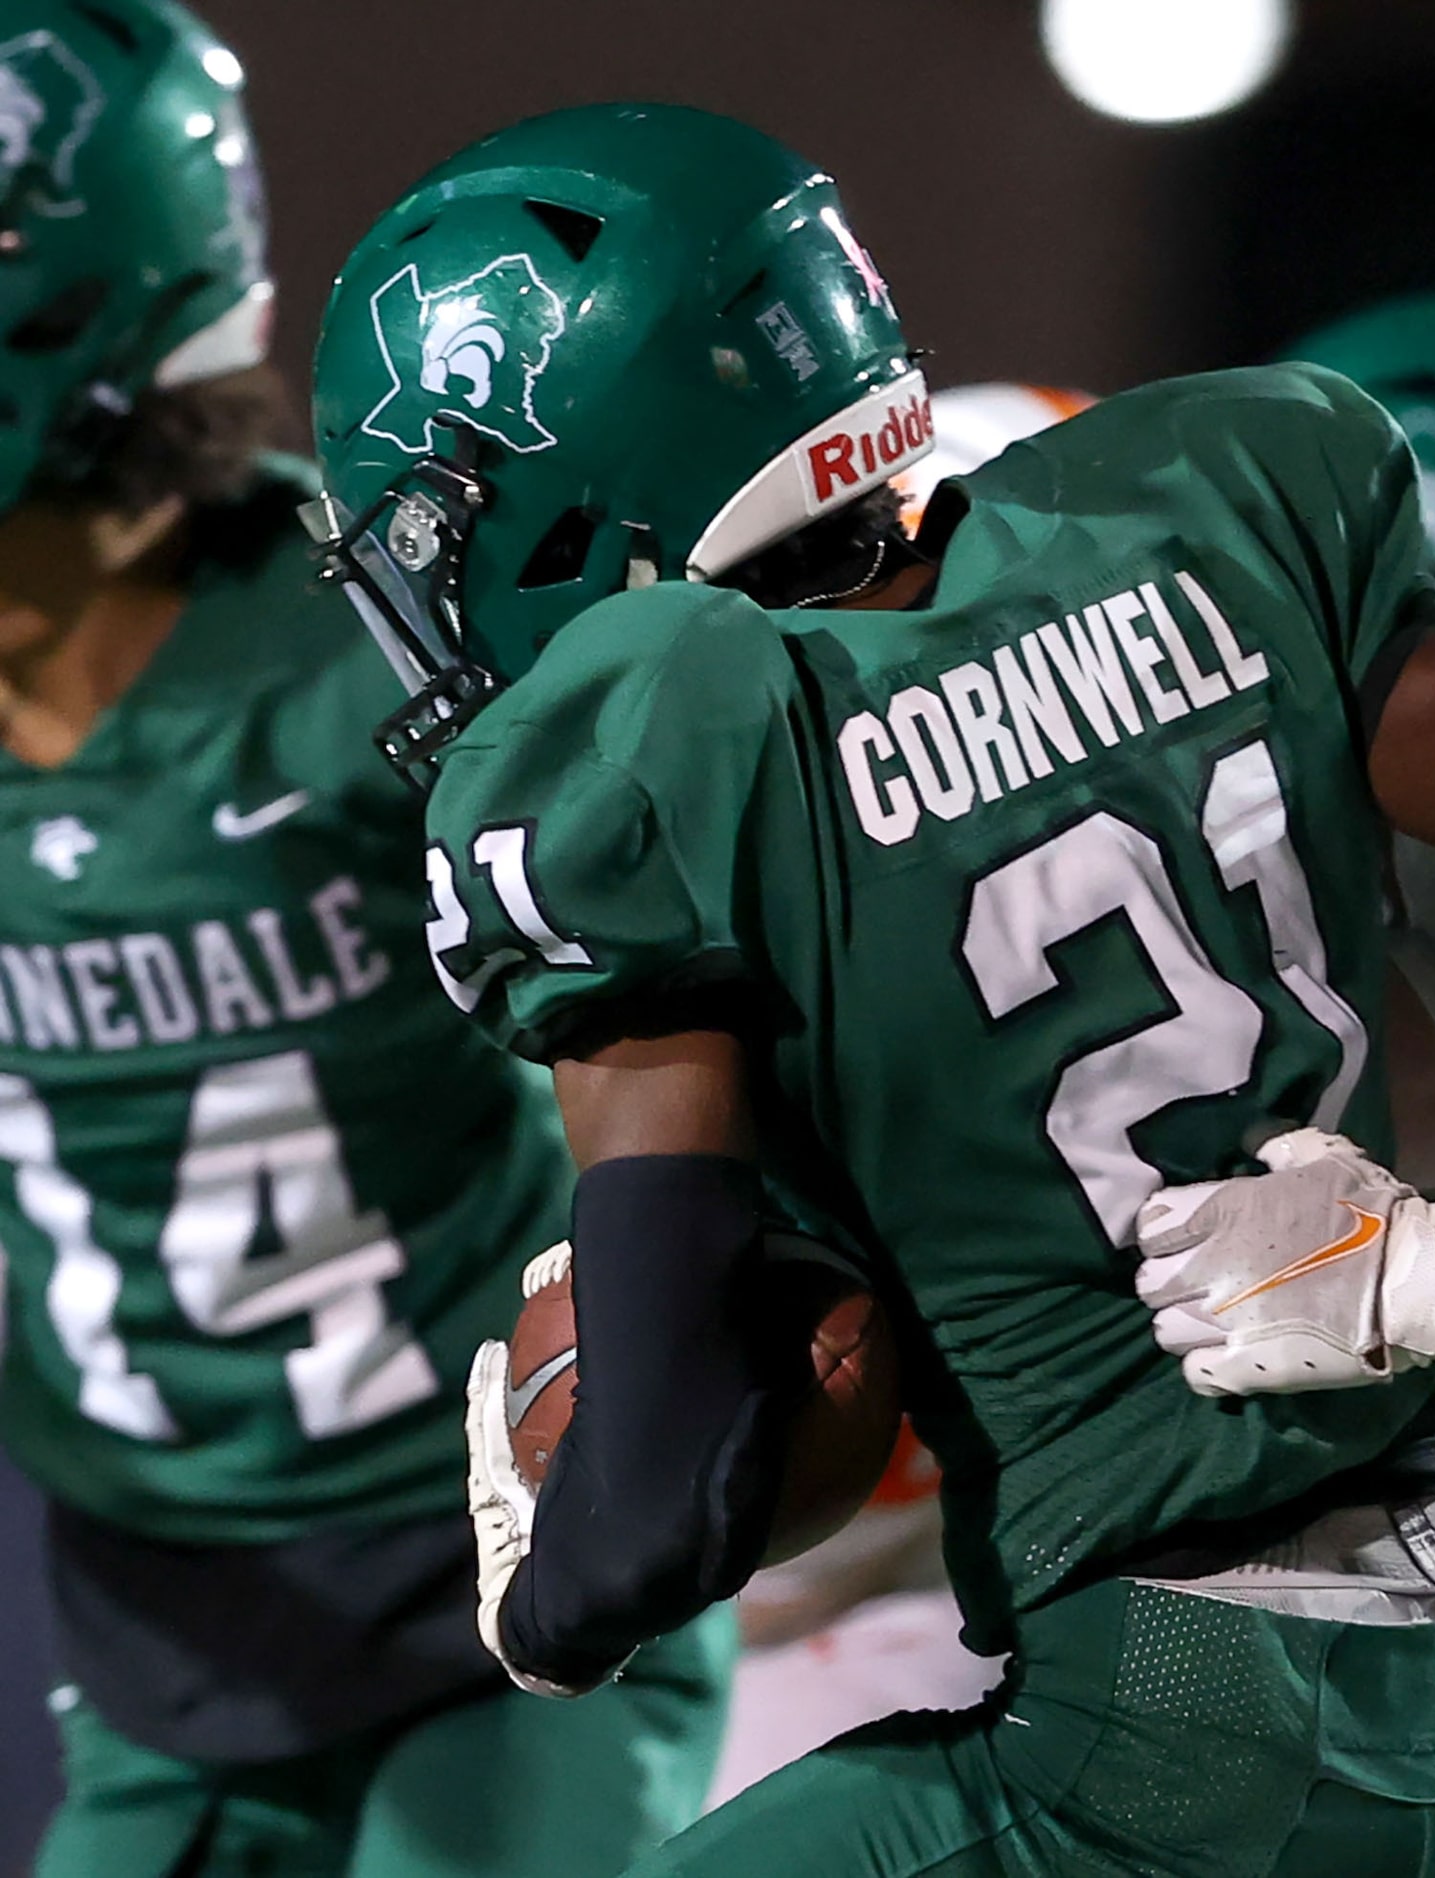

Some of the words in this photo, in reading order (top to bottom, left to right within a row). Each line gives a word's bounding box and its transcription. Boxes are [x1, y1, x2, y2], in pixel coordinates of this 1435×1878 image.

[837, 571, 1270, 847] CORNWELL
[0, 876, 391, 1050] NEDALE
[425, 826, 594, 1015] 21
[960, 739, 1370, 1250] 21
[0, 1049, 440, 1441] 14
